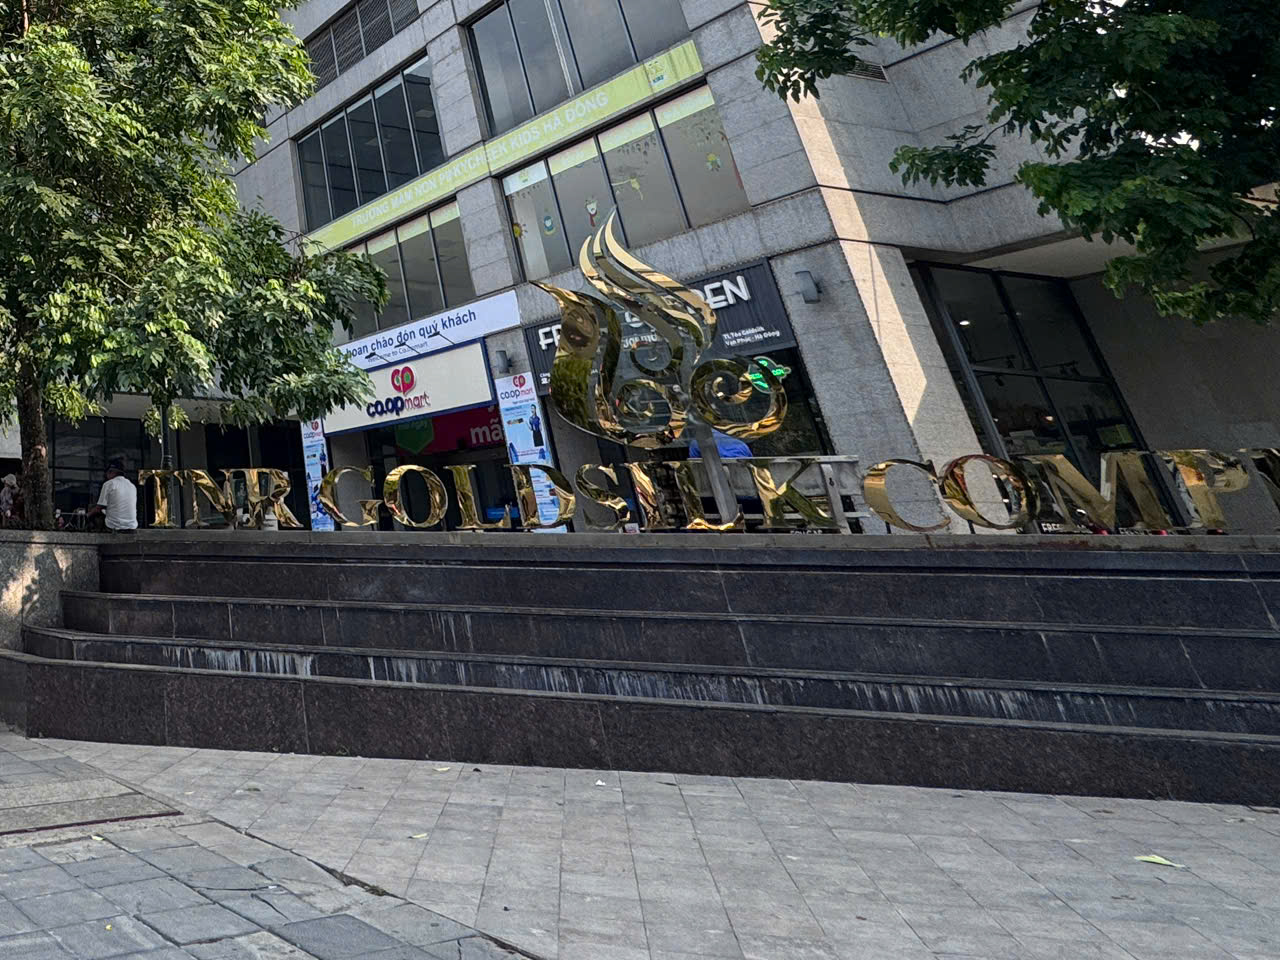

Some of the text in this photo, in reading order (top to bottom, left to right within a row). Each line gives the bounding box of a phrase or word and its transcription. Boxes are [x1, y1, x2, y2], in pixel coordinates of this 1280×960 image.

[509, 127, 540, 150] KIDS
[441, 309, 477, 330] khách
[138, 467, 304, 531] TNR
